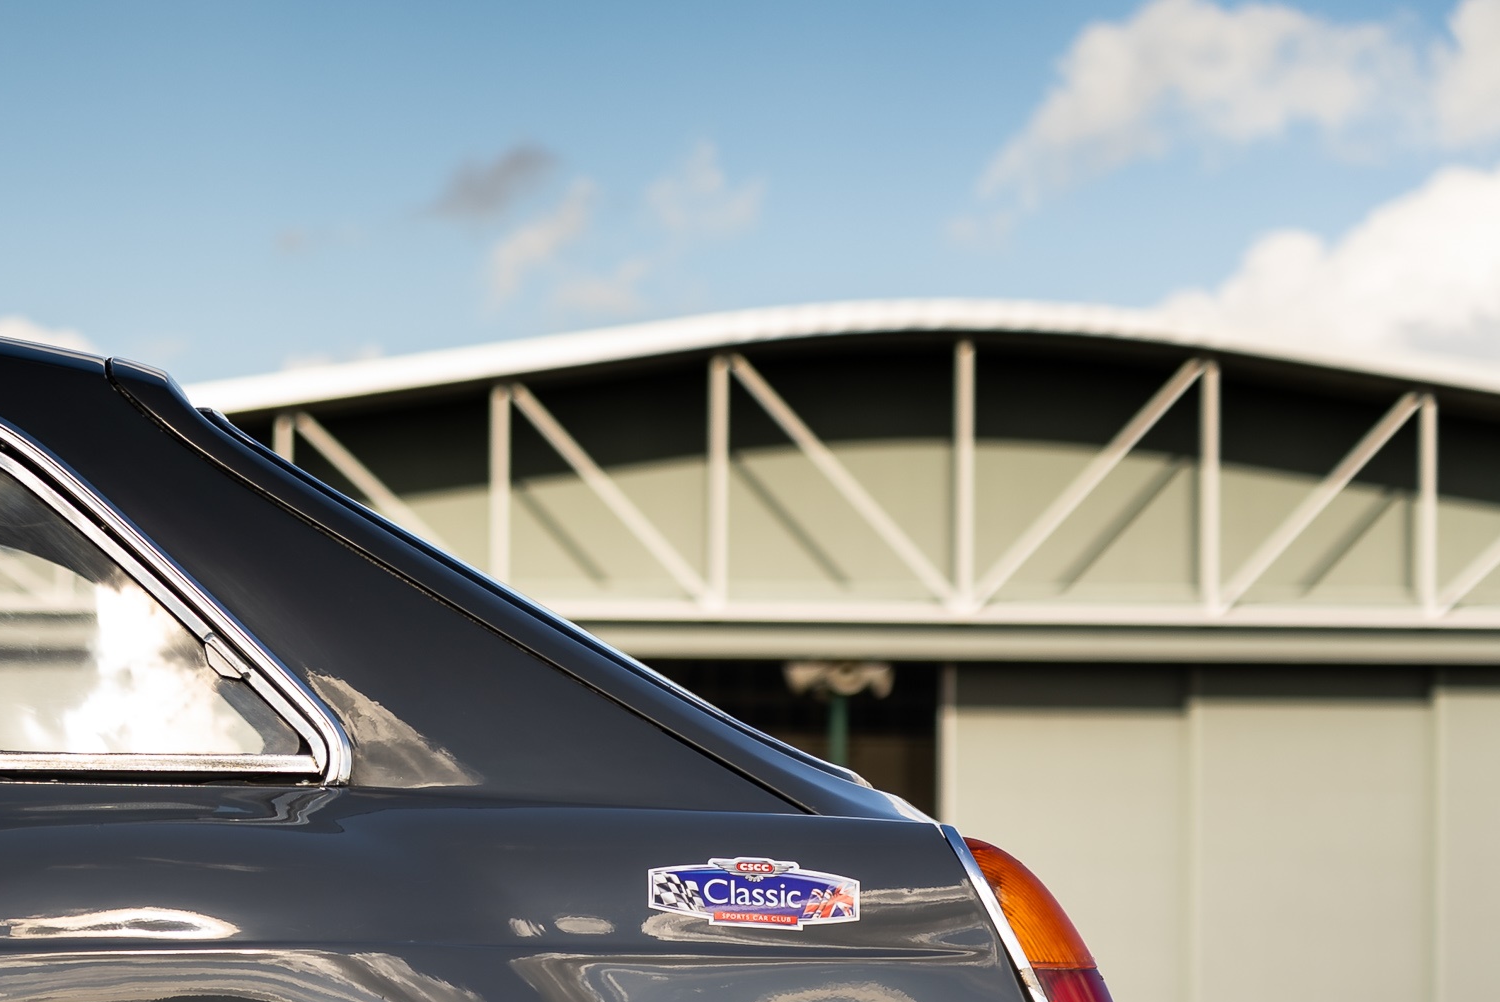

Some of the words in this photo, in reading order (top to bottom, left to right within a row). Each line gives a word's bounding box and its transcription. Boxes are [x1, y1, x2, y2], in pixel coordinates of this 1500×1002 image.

[739, 863, 770, 872] CSCC
[703, 878, 802, 909] Classic
[722, 912, 750, 921] SPORTS
[752, 913, 769, 921] CAR
[771, 914, 791, 923] CLUB
